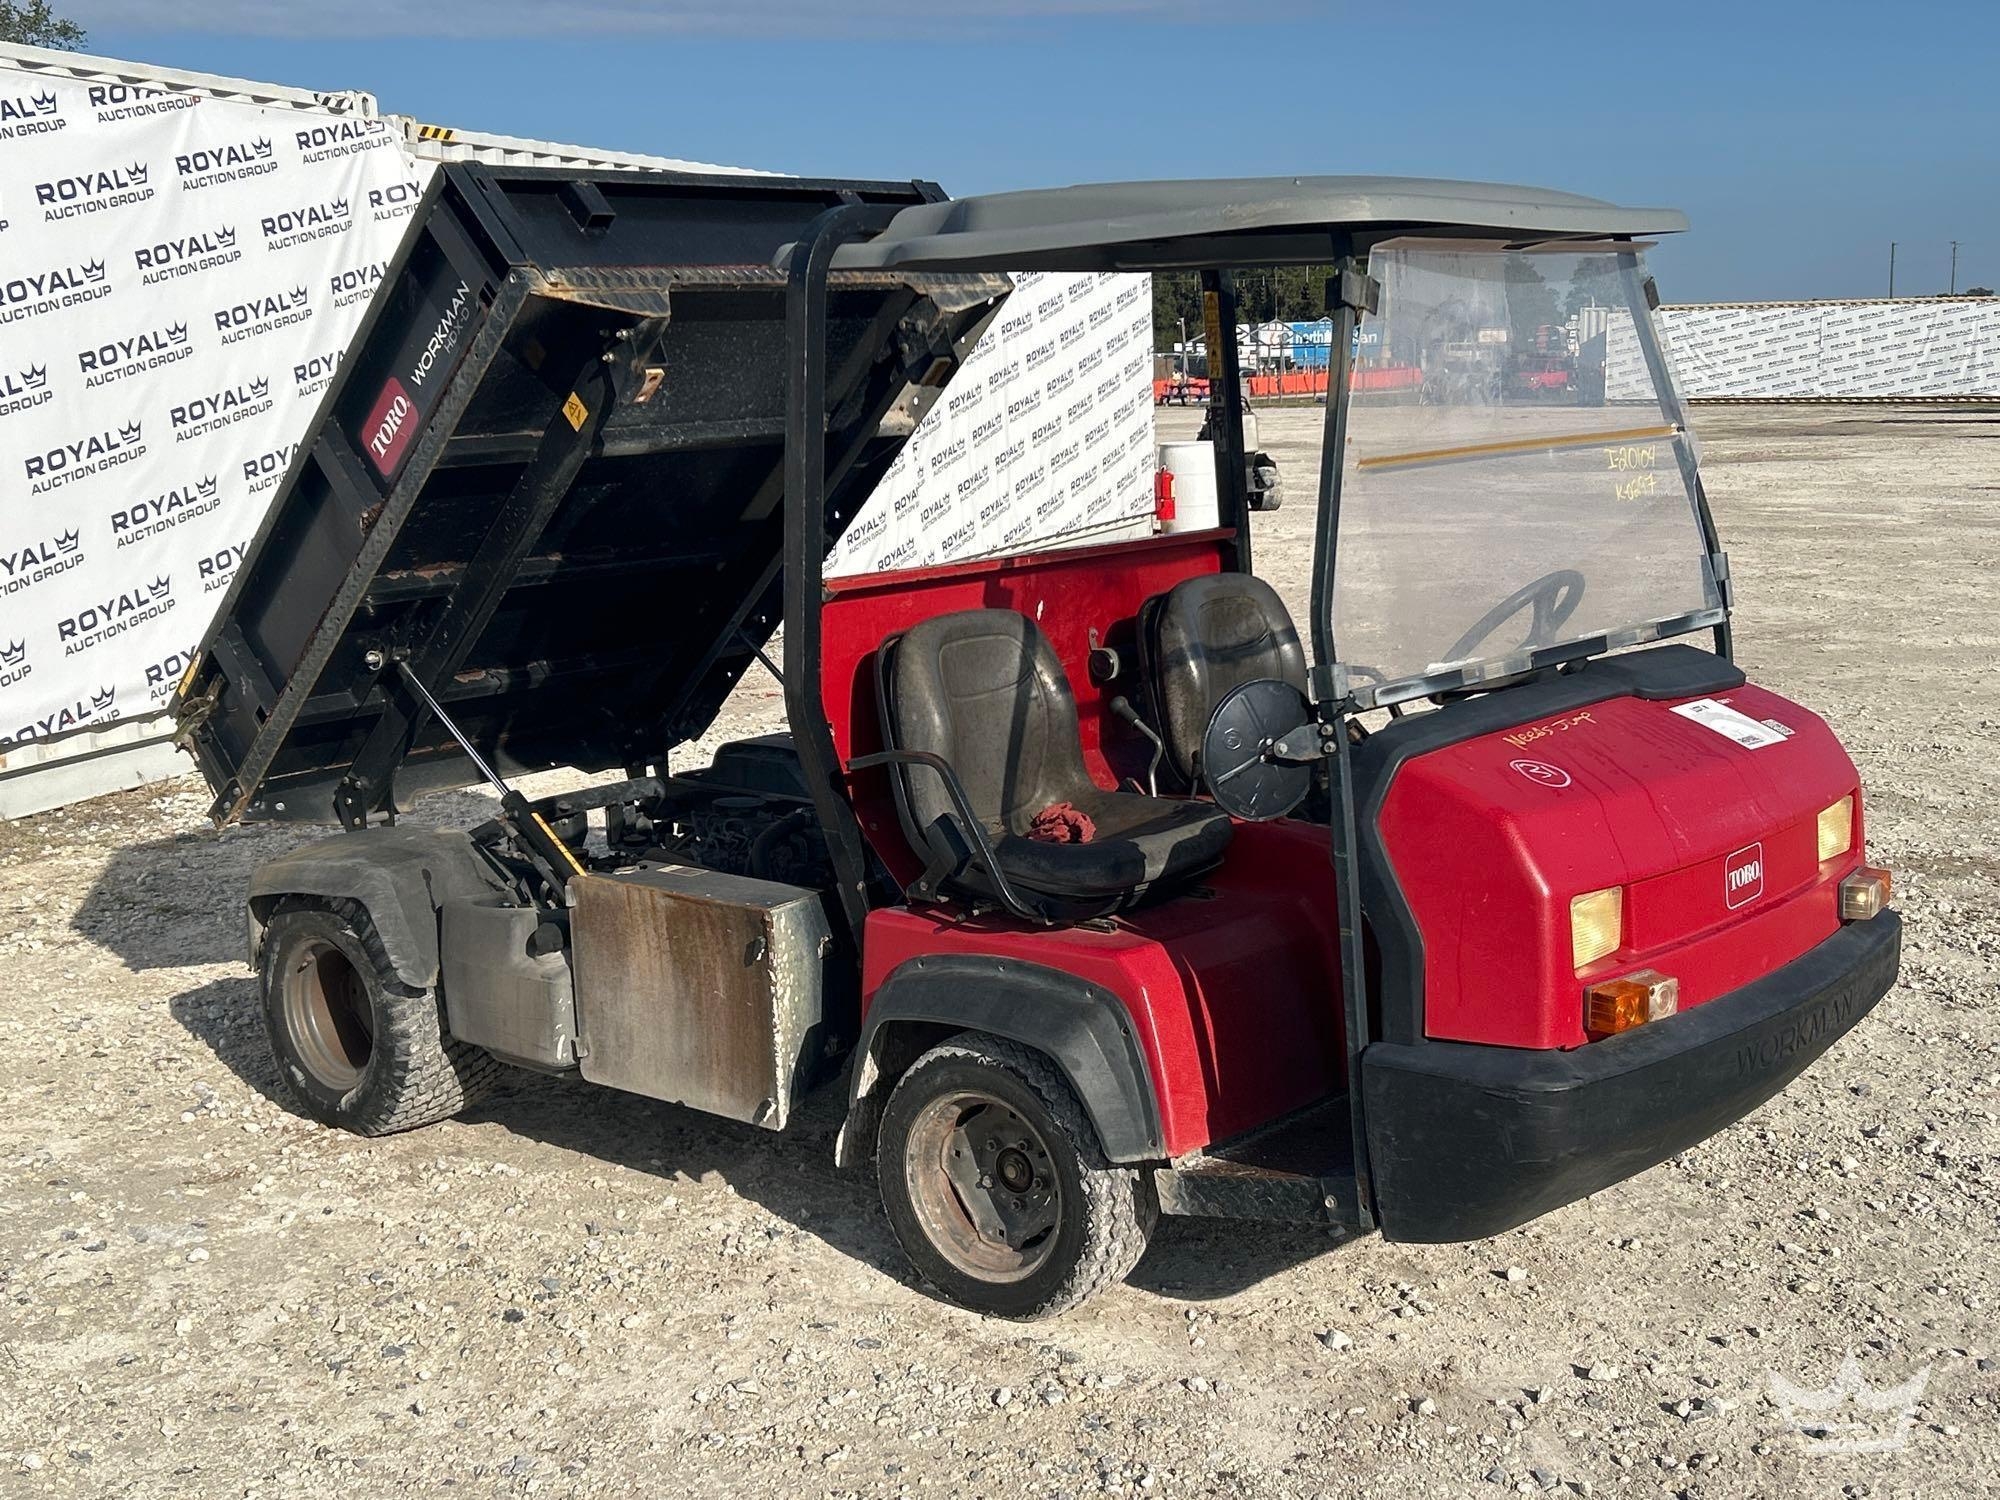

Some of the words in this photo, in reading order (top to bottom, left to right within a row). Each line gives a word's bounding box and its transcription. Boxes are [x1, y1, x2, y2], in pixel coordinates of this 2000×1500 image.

[97, 103, 156, 123] AUCTION
[158, 96, 201, 113] GROUP
[16, 118, 67, 136] GROUP
[295, 120, 366, 150] ROYAL
[175, 143, 256, 176] ROYAL
[303, 146, 350, 164] AUCTION
[350, 136, 393, 153] GROUP
[35, 169, 129, 206] ROYAL
[182, 169, 236, 191] AUCTION
[238, 161, 278, 179] GROUP
[44, 199, 108, 222] AUCTION
[109, 188, 155, 208] GROUP
[368, 180, 425, 208] ROY
[261, 203, 333, 237] ROYAL
[268, 229, 317, 252] AUCTION
[318, 220, 353, 238] GROUP
[134, 233, 218, 270] ROYAL
[142, 261, 198, 286] AUCTION
[199, 250, 242, 270] GROUP
[62, 284, 112, 308] GROUP
[1069, 279, 1088, 296] ROYAL
[1117, 290, 1134, 305] ROYAL
[214, 294, 291, 331] ROYAL
[1038, 297, 1059, 315] ROYAL
[1089, 307, 1108, 323] ROYAL
[221, 321, 273, 346] AUCTION
[274, 309, 313, 329] GROUP
[411, 280, 470, 386] WORKMAN
[443, 307, 470, 354] HDX-D
[1001, 316, 1027, 335] ROYAL
[1060, 325, 1080, 343] ROYAL
[1132, 316, 1147, 332] ROYAL
[78, 331, 168, 373] ROYAL
[1026, 344, 1050, 364] ROYAL
[1107, 334, 1125, 350] ROYAL
[85, 361, 147, 390] AUCTION
[149, 346, 194, 369] GROUP
[1079, 352, 1098, 370] ROYAL
[1124, 359, 1140, 375] ROYAL
[989, 367, 1011, 386] ROYAL
[1047, 372, 1070, 392] ROYAL
[1098, 377, 1116, 396] ROYAL
[170, 386, 251, 427] ROYAL
[949, 390, 976, 412] ROYAL
[1008, 395, 1034, 415] ROYAL
[1068, 399, 1088, 418] ROYAL
[1114, 403, 1131, 421] ROYAL
[176, 415, 231, 443] AUCTION
[233, 399, 274, 422] GROUP
[371, 394, 410, 458] TORO
[973, 418, 996, 441] ROYAL
[1032, 422, 1056, 442] ROYAL
[1085, 424, 1105, 444] ROYAL
[1130, 426, 1144, 443] ROYAL
[24, 431, 121, 479] ROYAL
[931, 444, 957, 468] ROYAL
[995, 445, 1018, 466] ROYAL
[1051, 445, 1073, 468] ROYAL
[1103, 447, 1121, 466] ROYAL
[31, 463, 96, 496] AUCTION
[98, 445, 147, 471] GROUP
[958, 470, 983, 495] ROYAL
[1016, 471, 1039, 494] ROYAL
[1071, 469, 1094, 491] ROYAL
[1117, 471, 1134, 490] ROYAL
[111, 486, 198, 533] ROYAL
[981, 498, 1003, 521] ROYAL
[1037, 494, 1061, 516] ROYAL
[1087, 494, 1107, 514] ROYAL
[1130, 491, 1149, 510] ROYAL
[117, 516, 176, 549] AUCTION
[178, 498, 222, 524] GROUP
[847, 518, 879, 546] ROYAL
[1004, 522, 1026, 544] ROYAL
[942, 524, 968, 552] ROYAL
[33, 553, 85, 583] GROUP
[878, 543, 908, 572] ROYAL
[58, 588, 150, 642] ROYAL
[65, 620, 127, 658] AUCTION
[130, 599, 176, 627] GROUP
[1502, 724, 1554, 751] Needs
[1729, 861, 1760, 891] TORO
[1737, 988, 1853, 1077] WORKMAN
